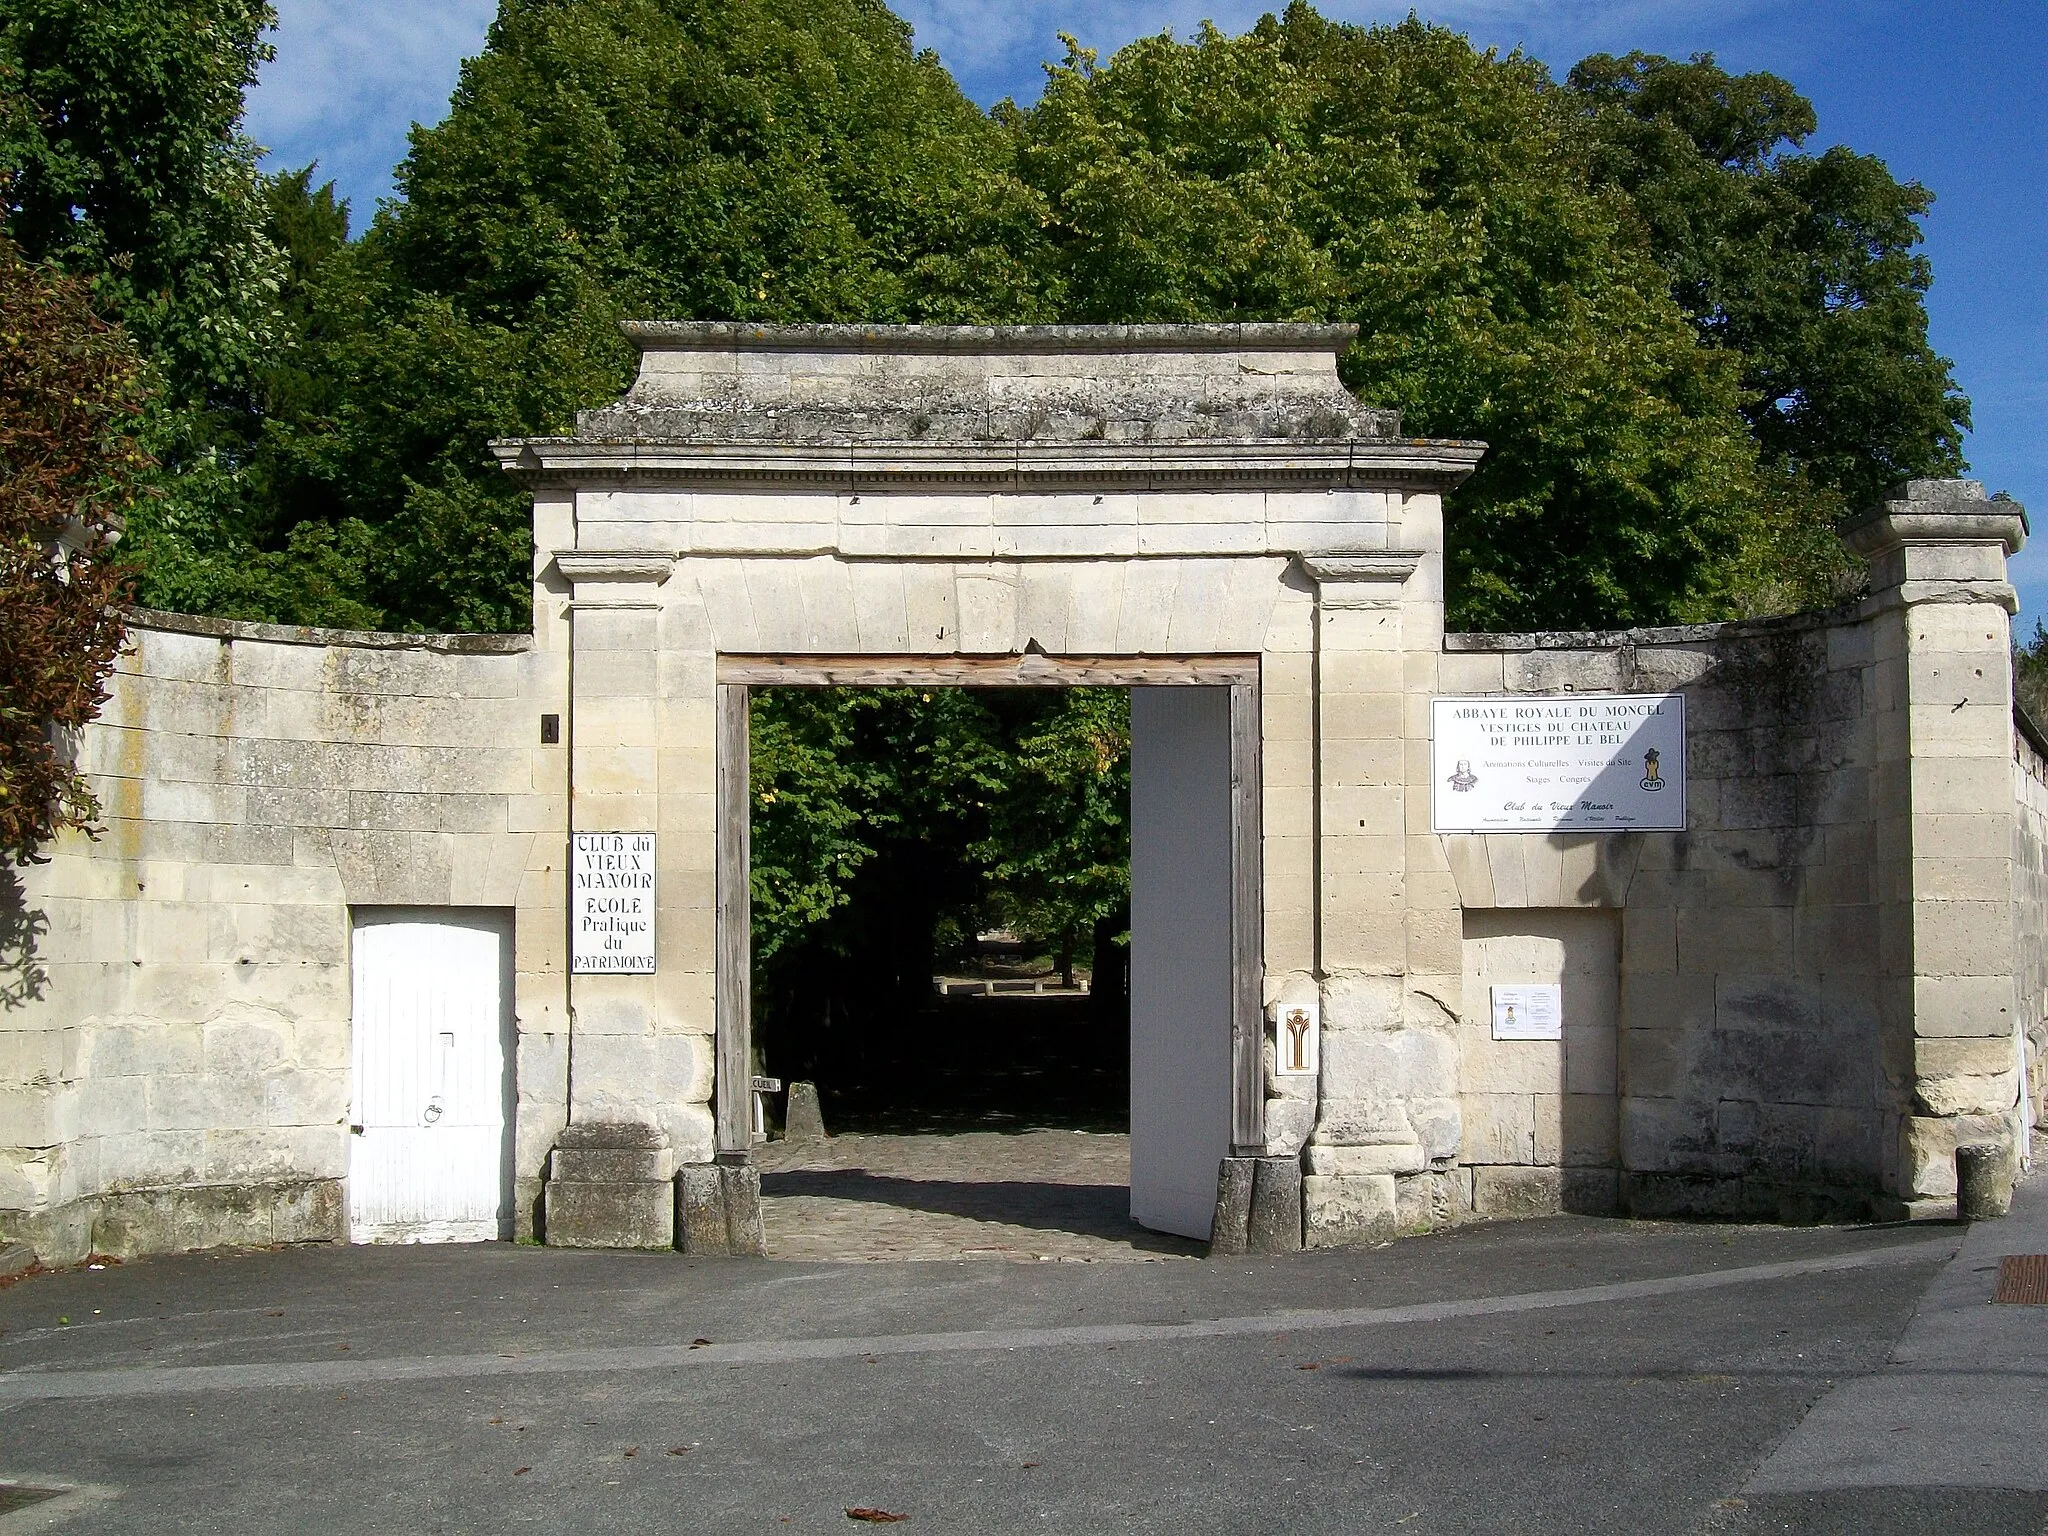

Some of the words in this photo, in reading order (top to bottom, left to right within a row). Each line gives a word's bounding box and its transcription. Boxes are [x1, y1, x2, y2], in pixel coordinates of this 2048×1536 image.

[1453, 707, 1508, 719] ABBAYE
[1515, 706, 1572, 719] ROYALE
[1579, 706, 1598, 718] DU
[1605, 704, 1665, 717] MONCEL
[1480, 723, 1541, 733] VESTIGES
[1548, 722, 1565, 732] DU
[1570, 720, 1631, 732] CHATEAU
[1491, 736, 1507, 747] DE
[1514, 735, 1571, 746] PHILIPPE
[1577, 735, 1593, 745] LE
[1599, 734, 1624, 745] BEL
[1482, 760, 1526, 768] Animations
[1527, 759, 1570, 768] Culturelles
[1578, 759, 1604, 767] Visites
[1617, 758, 1632, 766] Site
[1526, 775, 1551, 786] Stages
[1504, 800, 1525, 811] Club
[1531, 801, 1543, 811] du
[1550, 801, 1574, 811] Vieux
[1580, 800, 1615, 811] Manoir
[577, 836, 624, 852] CLUB
[585, 854, 641, 870] VIEUX
[577, 872, 652, 889] MANOIR
[585, 897, 642, 914] ECOLE
[582, 916, 647, 936] Pratique
[603, 935, 622, 950] du
[573, 955, 656, 969] PATRIMOINE
